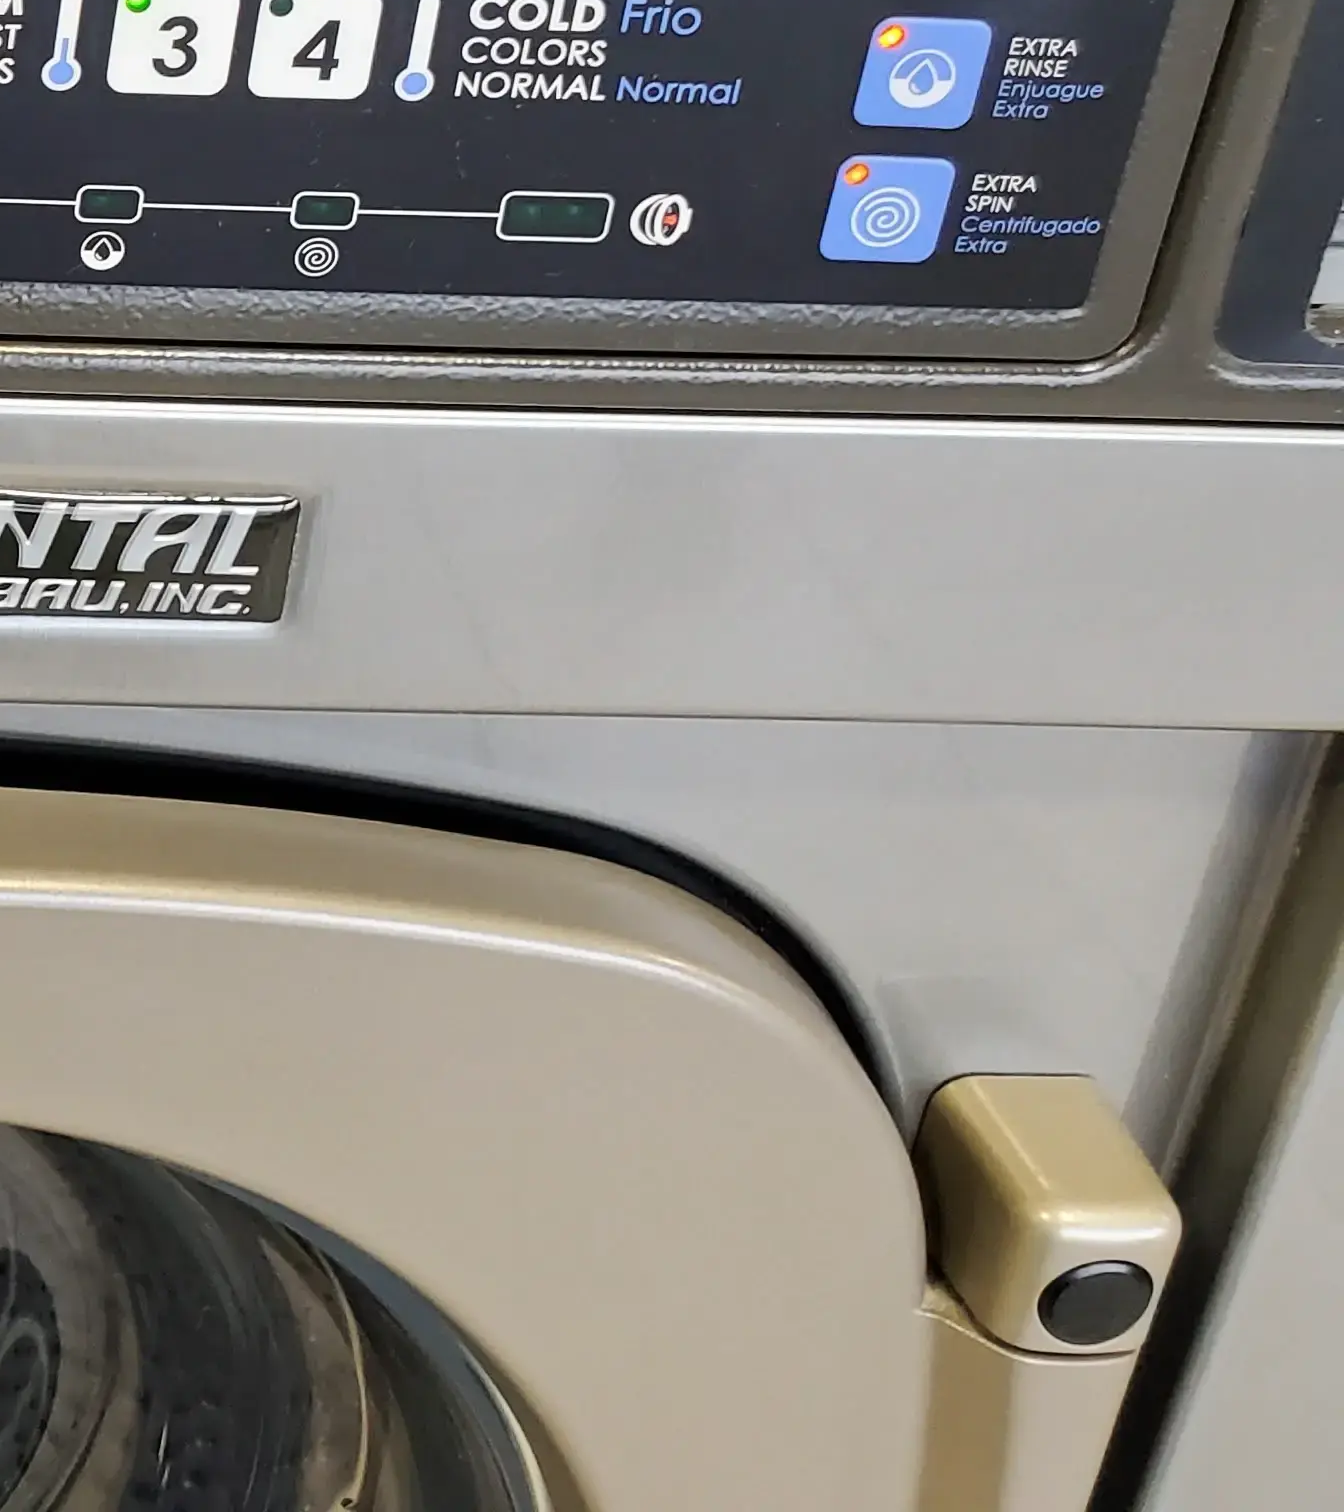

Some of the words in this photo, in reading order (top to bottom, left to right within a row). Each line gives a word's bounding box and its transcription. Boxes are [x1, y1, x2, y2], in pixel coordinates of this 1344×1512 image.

[151, 16, 199, 77] 3
[292, 19, 341, 80] 4
[461, 36, 606, 67] COLORS
[1008, 37, 1078, 58] EXTRA
[1003, 59, 1068, 78] RINSE
[454, 71, 606, 102] NORMAL
[616, 76, 742, 106] Normal
[998, 80, 1104, 101] Enjuague
[992, 100, 1049, 119] Extra
[971, 173, 1036, 193] EXTRA
[965, 195, 1014, 214] SPIN
[960, 216, 1100, 236] Centrifugado
[954, 236, 1008, 254] Extra
[136, 581, 252, 615] INC.
